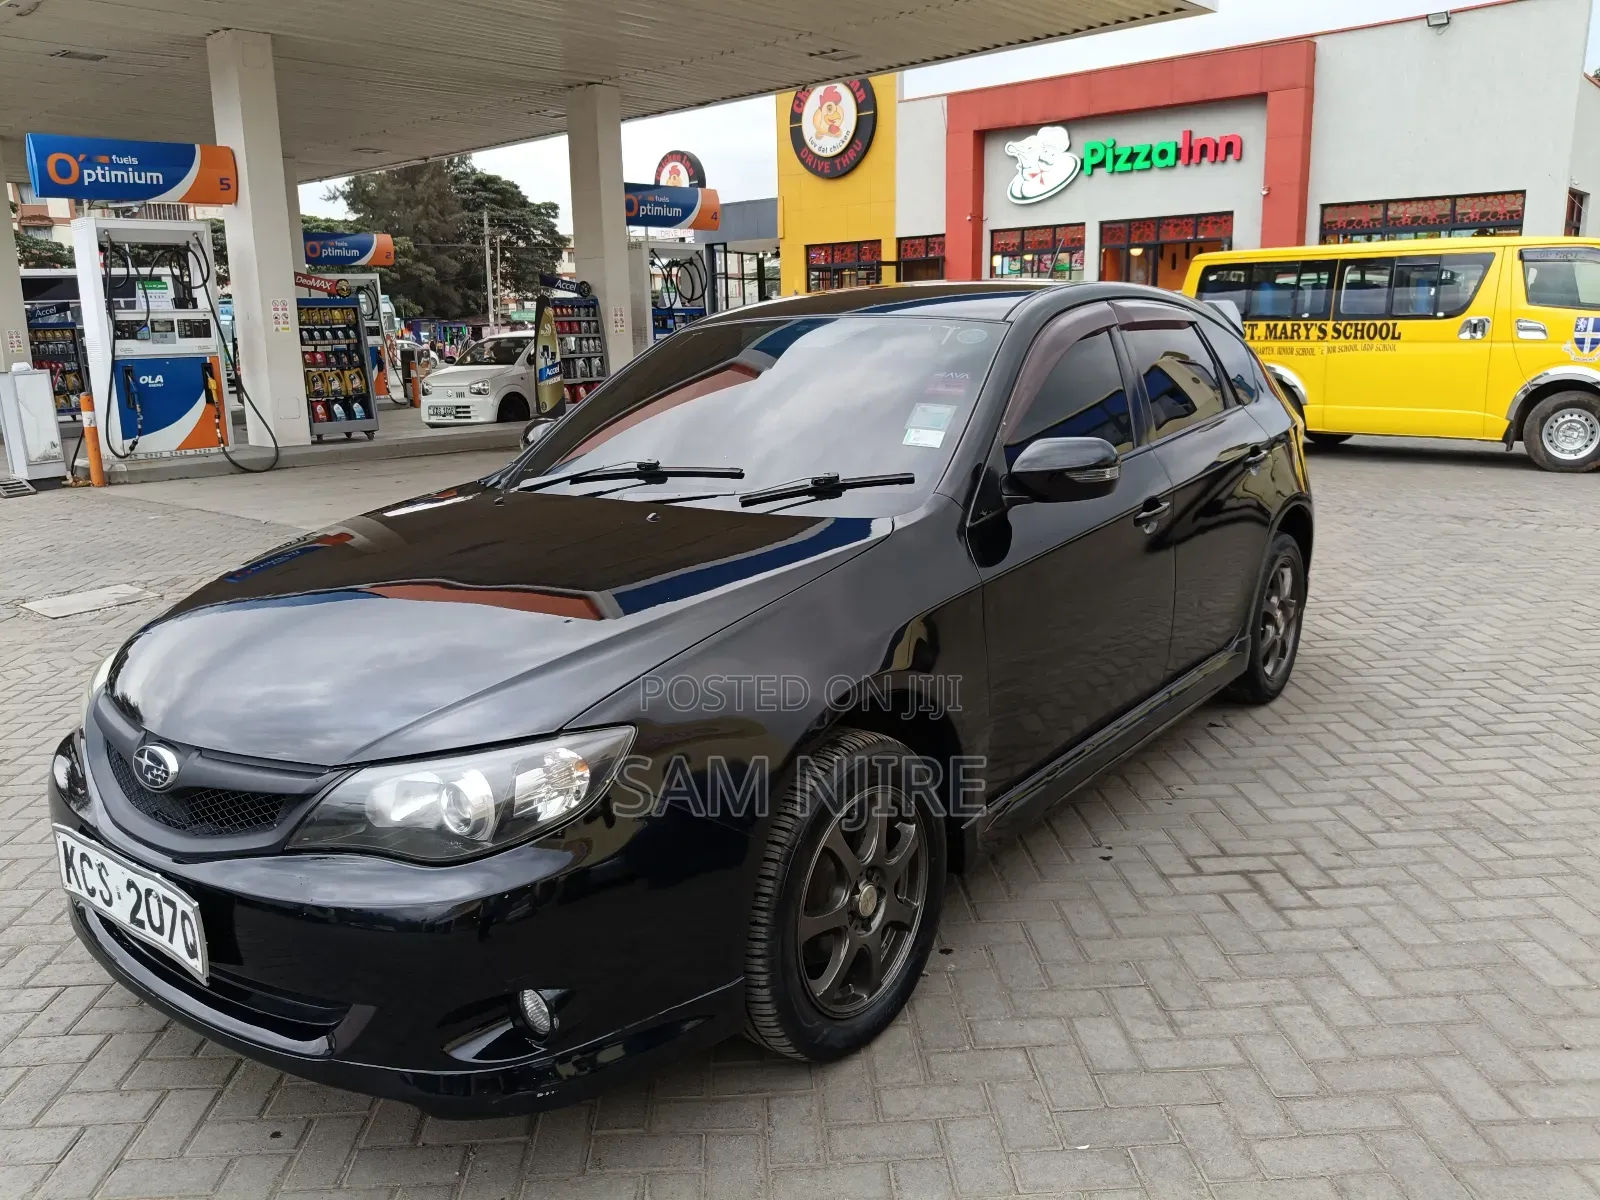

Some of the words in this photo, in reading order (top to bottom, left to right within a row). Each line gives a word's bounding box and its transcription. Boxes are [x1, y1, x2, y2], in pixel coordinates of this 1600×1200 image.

[808, 136, 817, 148] luv
[829, 130, 851, 152] chicken
[800, 147, 831, 173] DRIVE
[834, 140, 863, 171] THRU
[1084, 138, 1177, 176] Pizza
[1180, 129, 1243, 166] Inn
[111, 154, 139, 165] fuels
[219, 177, 232, 191] 5
[655, 195, 670, 203] fuels
[711, 211, 718, 221] 4
[385, 251, 392, 259] 2
[295, 275, 333, 290] DeoMAX
[555, 279, 577, 292] Accel
[35, 305, 57, 318] Accel
[1264, 322, 1328, 341] MARY'S
[1331, 322, 1402, 341] SCHOOL
[139, 374, 164, 384] OLA
[62, 840, 113, 908] KCS
